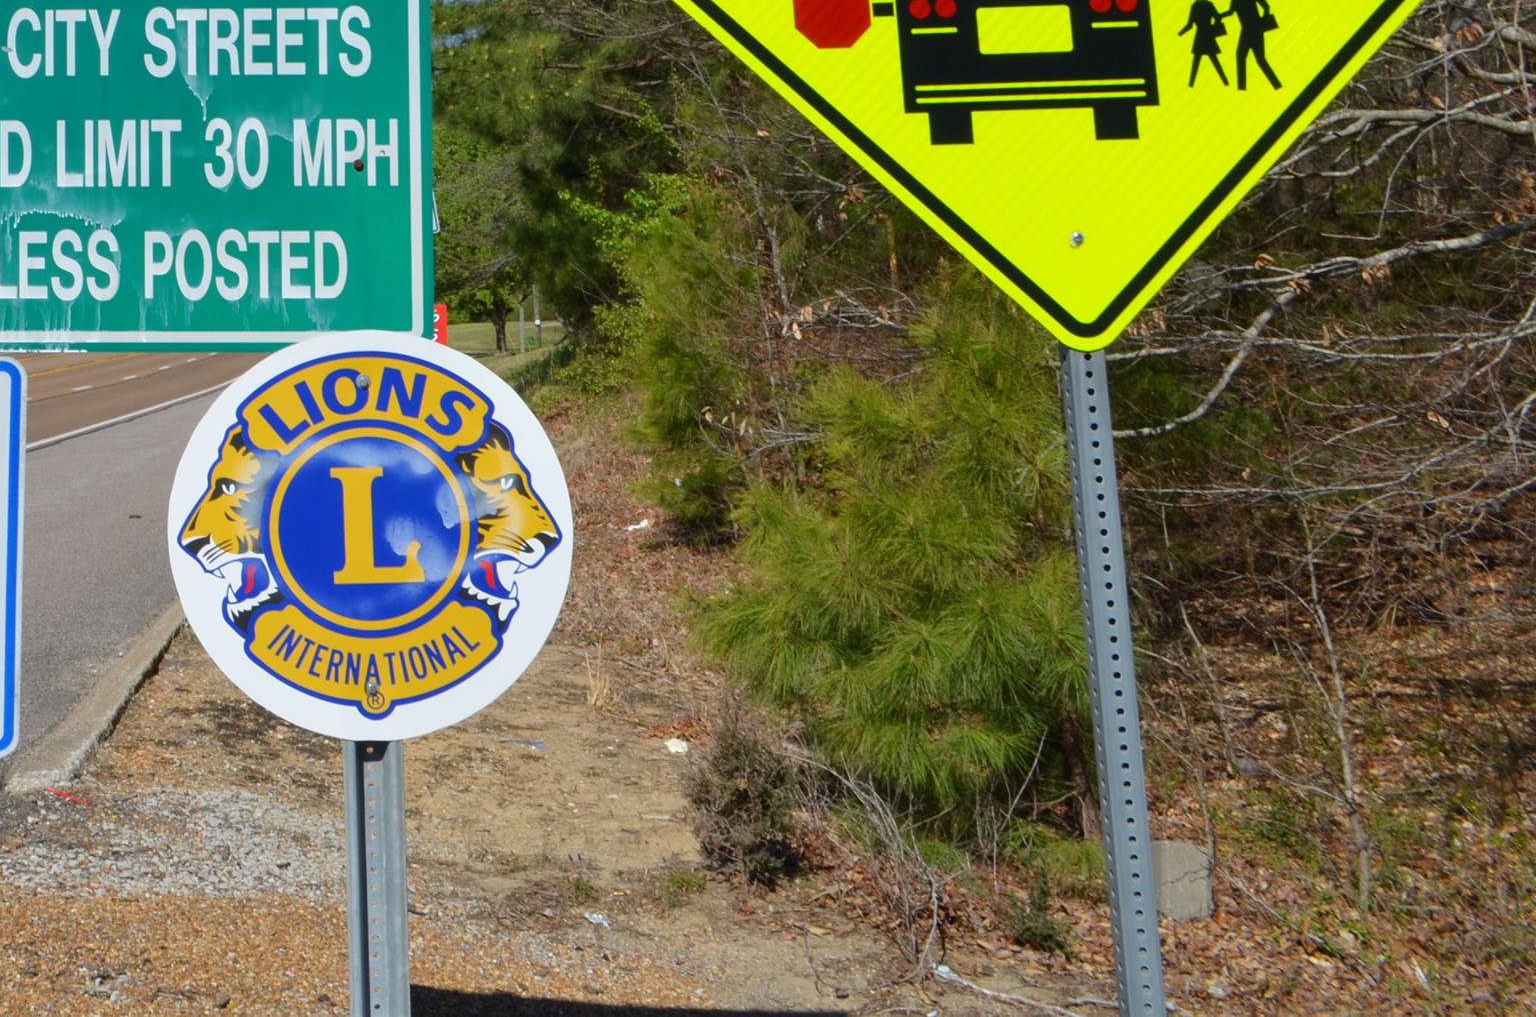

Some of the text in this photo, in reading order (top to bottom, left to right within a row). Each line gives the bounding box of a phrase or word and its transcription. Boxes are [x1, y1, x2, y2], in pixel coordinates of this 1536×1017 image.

[7, 7, 121, 79] CITY
[144, 5, 373, 78] STREETS
[56, 119, 182, 188] LIMIT
[204, 117, 270, 190] 30
[292, 118, 400, 187] MPH
[144, 228, 349, 302] POSTED
[258, 366, 476, 446] LIONS
[329, 467, 426, 585] L
[267, 624, 481, 686] INTERNATIONAL
